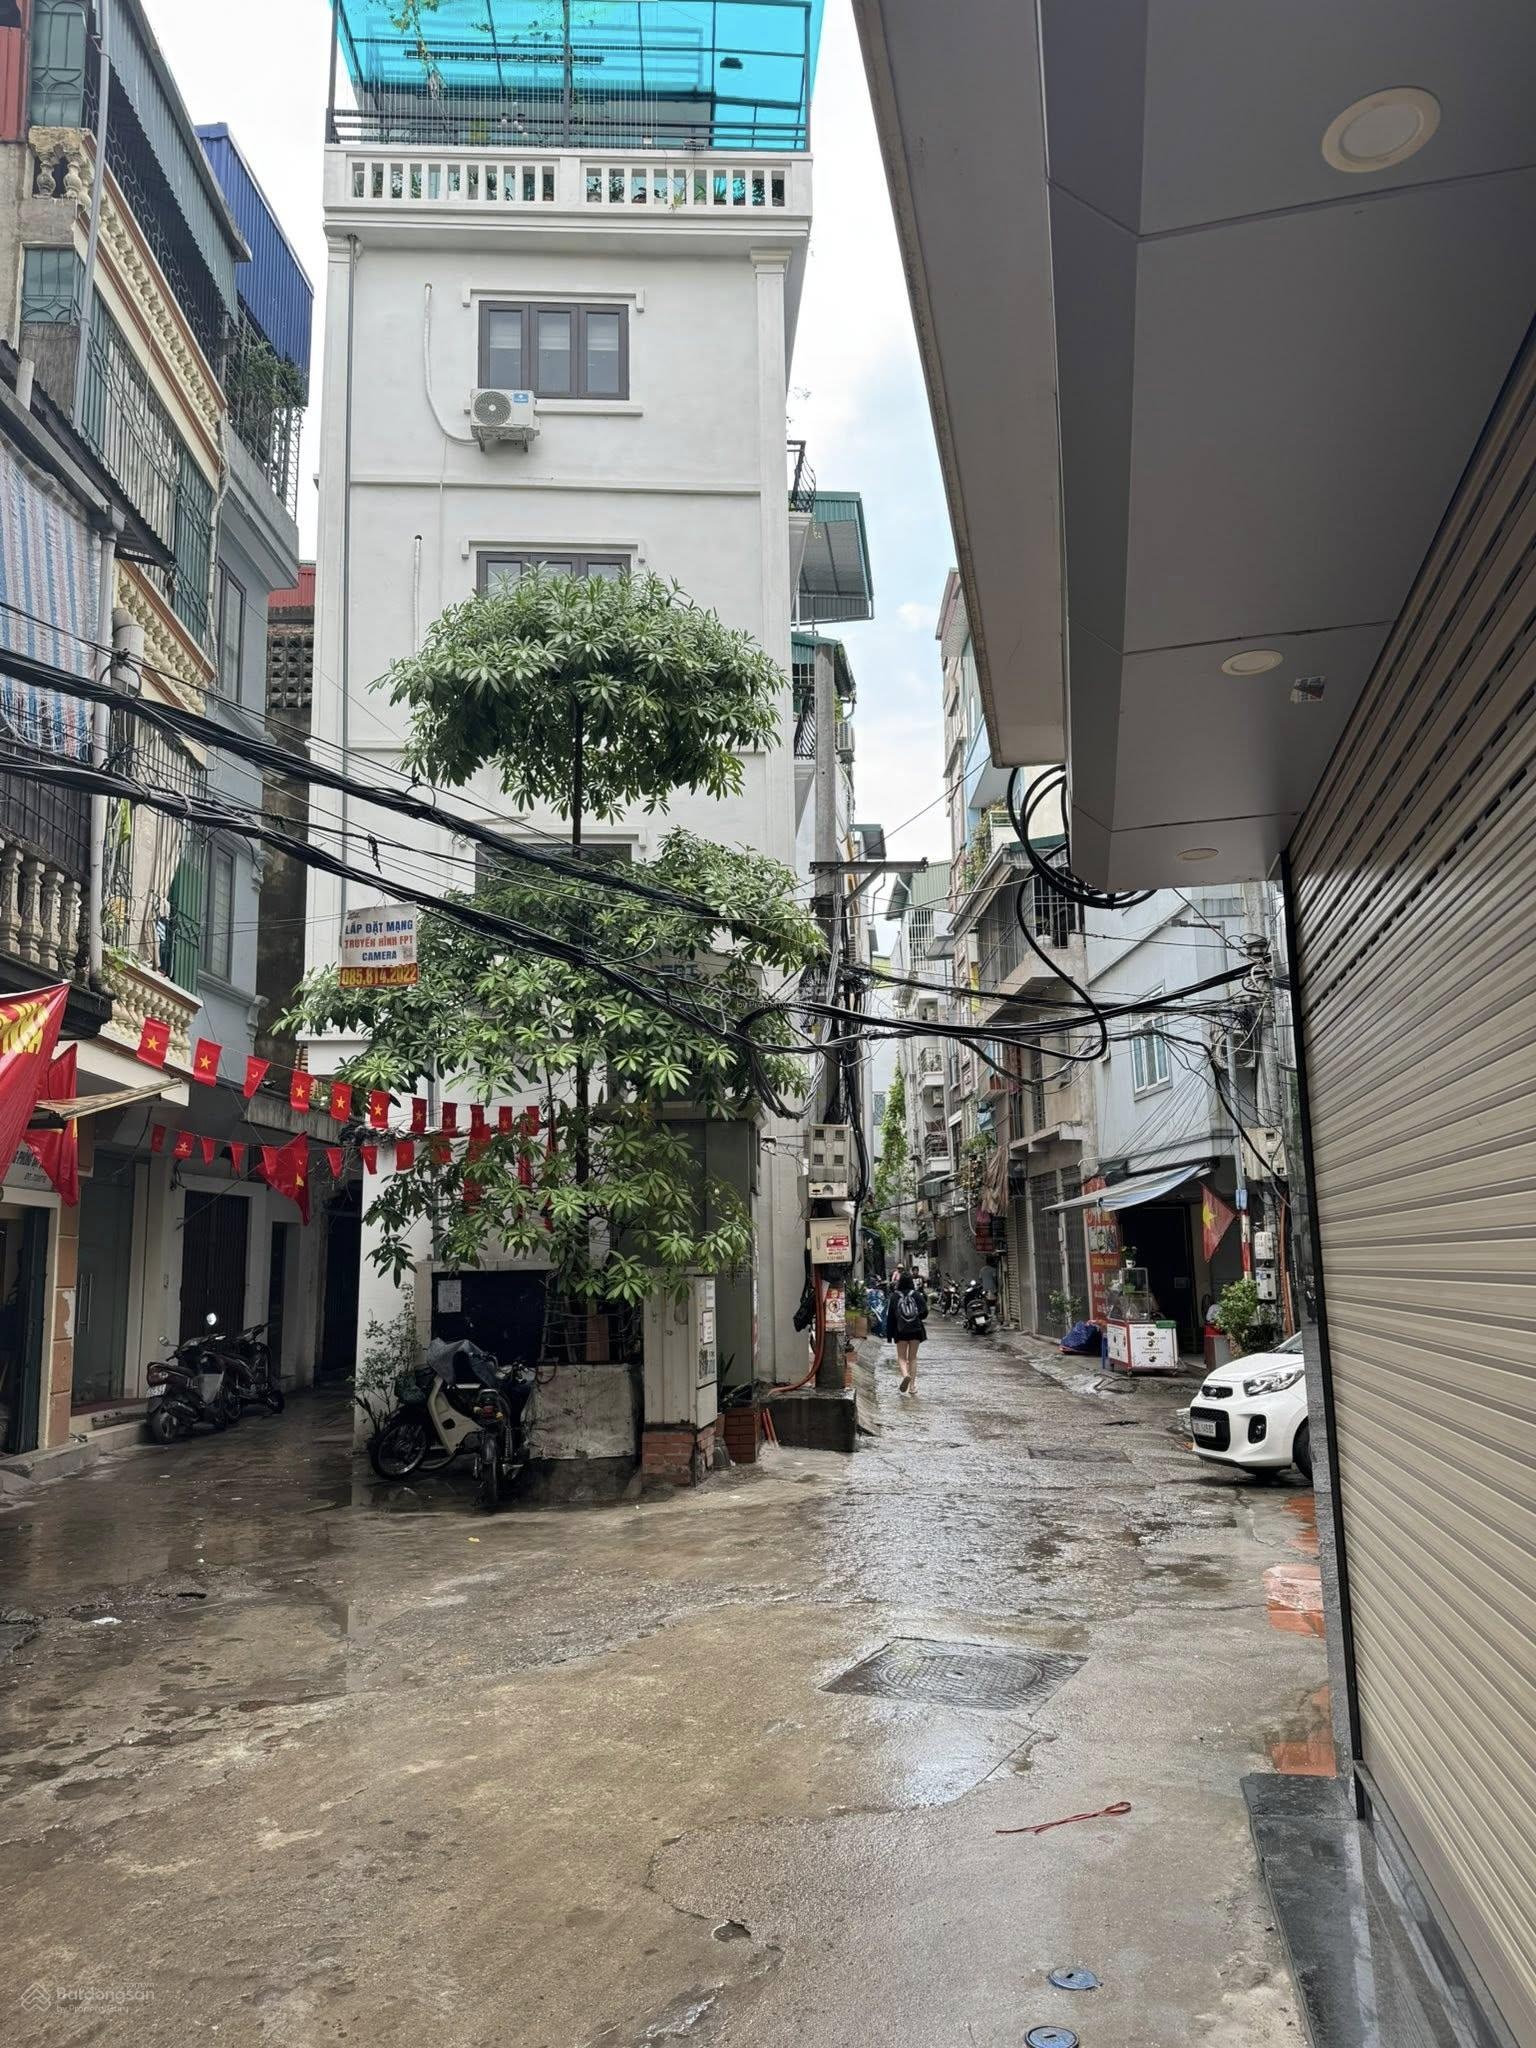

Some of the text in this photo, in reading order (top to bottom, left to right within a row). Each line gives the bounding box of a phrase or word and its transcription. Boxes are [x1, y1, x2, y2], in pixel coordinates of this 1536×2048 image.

[345, 919, 413, 936] LẮP ĐẶT MẠNG
[379, 935, 398, 947] HÌNH
[400, 935, 413, 945] FPT
[362, 950, 397, 961] CAMERA
